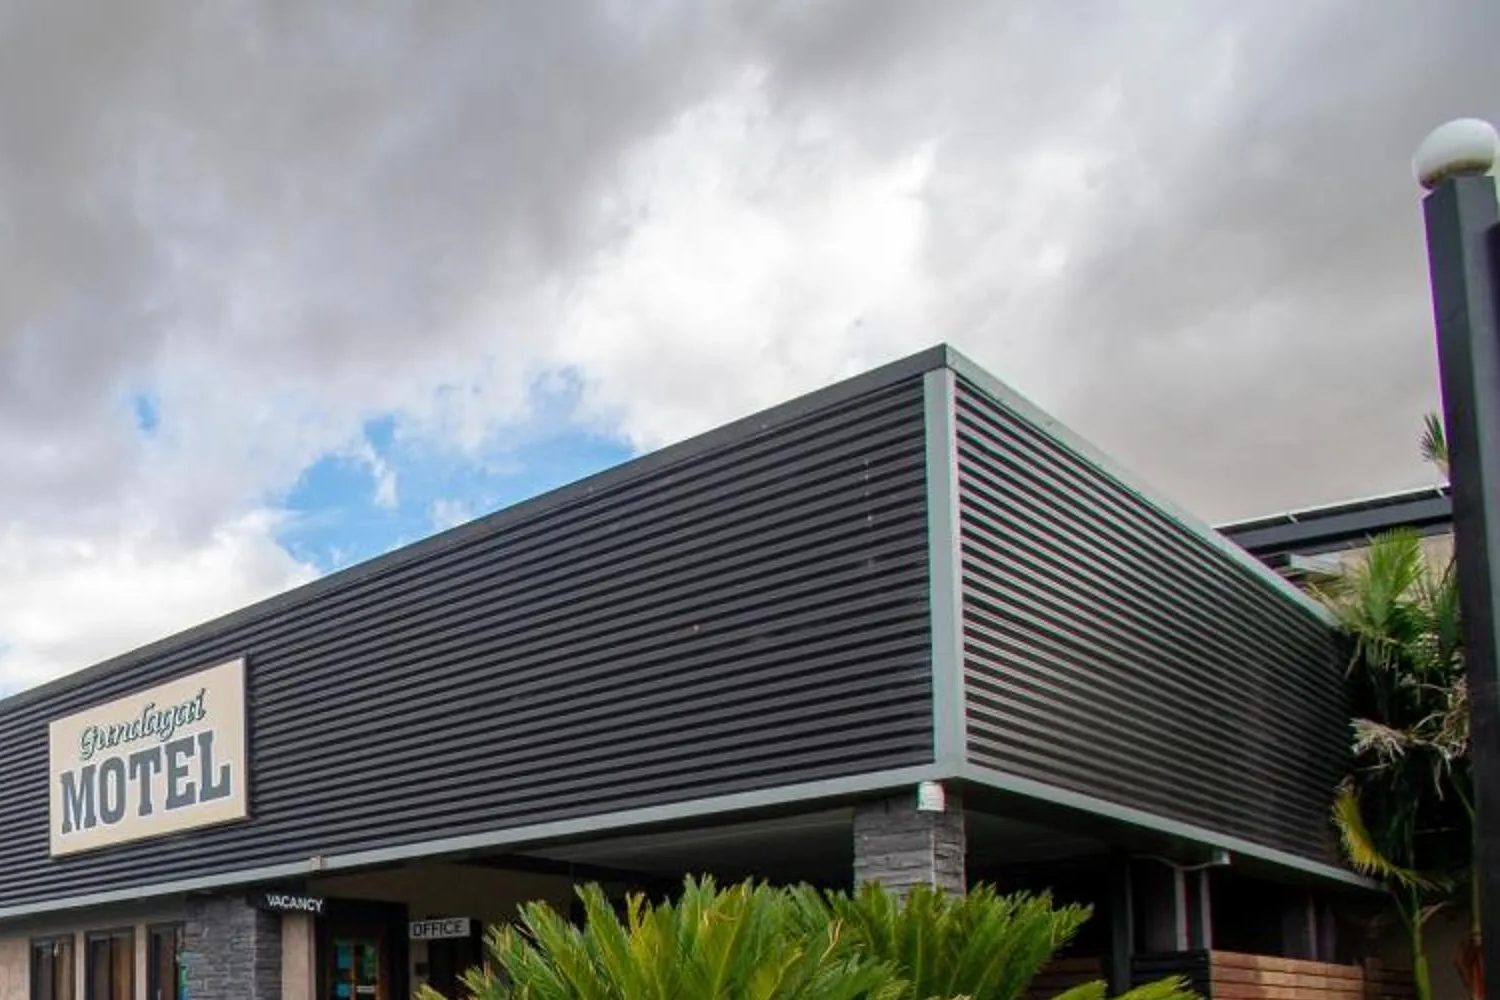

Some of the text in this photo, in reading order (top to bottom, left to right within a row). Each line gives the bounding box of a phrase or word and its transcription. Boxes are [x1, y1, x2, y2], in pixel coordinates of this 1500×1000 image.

[60, 730, 231, 834] MOTEL
[267, 894, 324, 913] VACANCY
[413, 920, 463, 937] OFFICE
